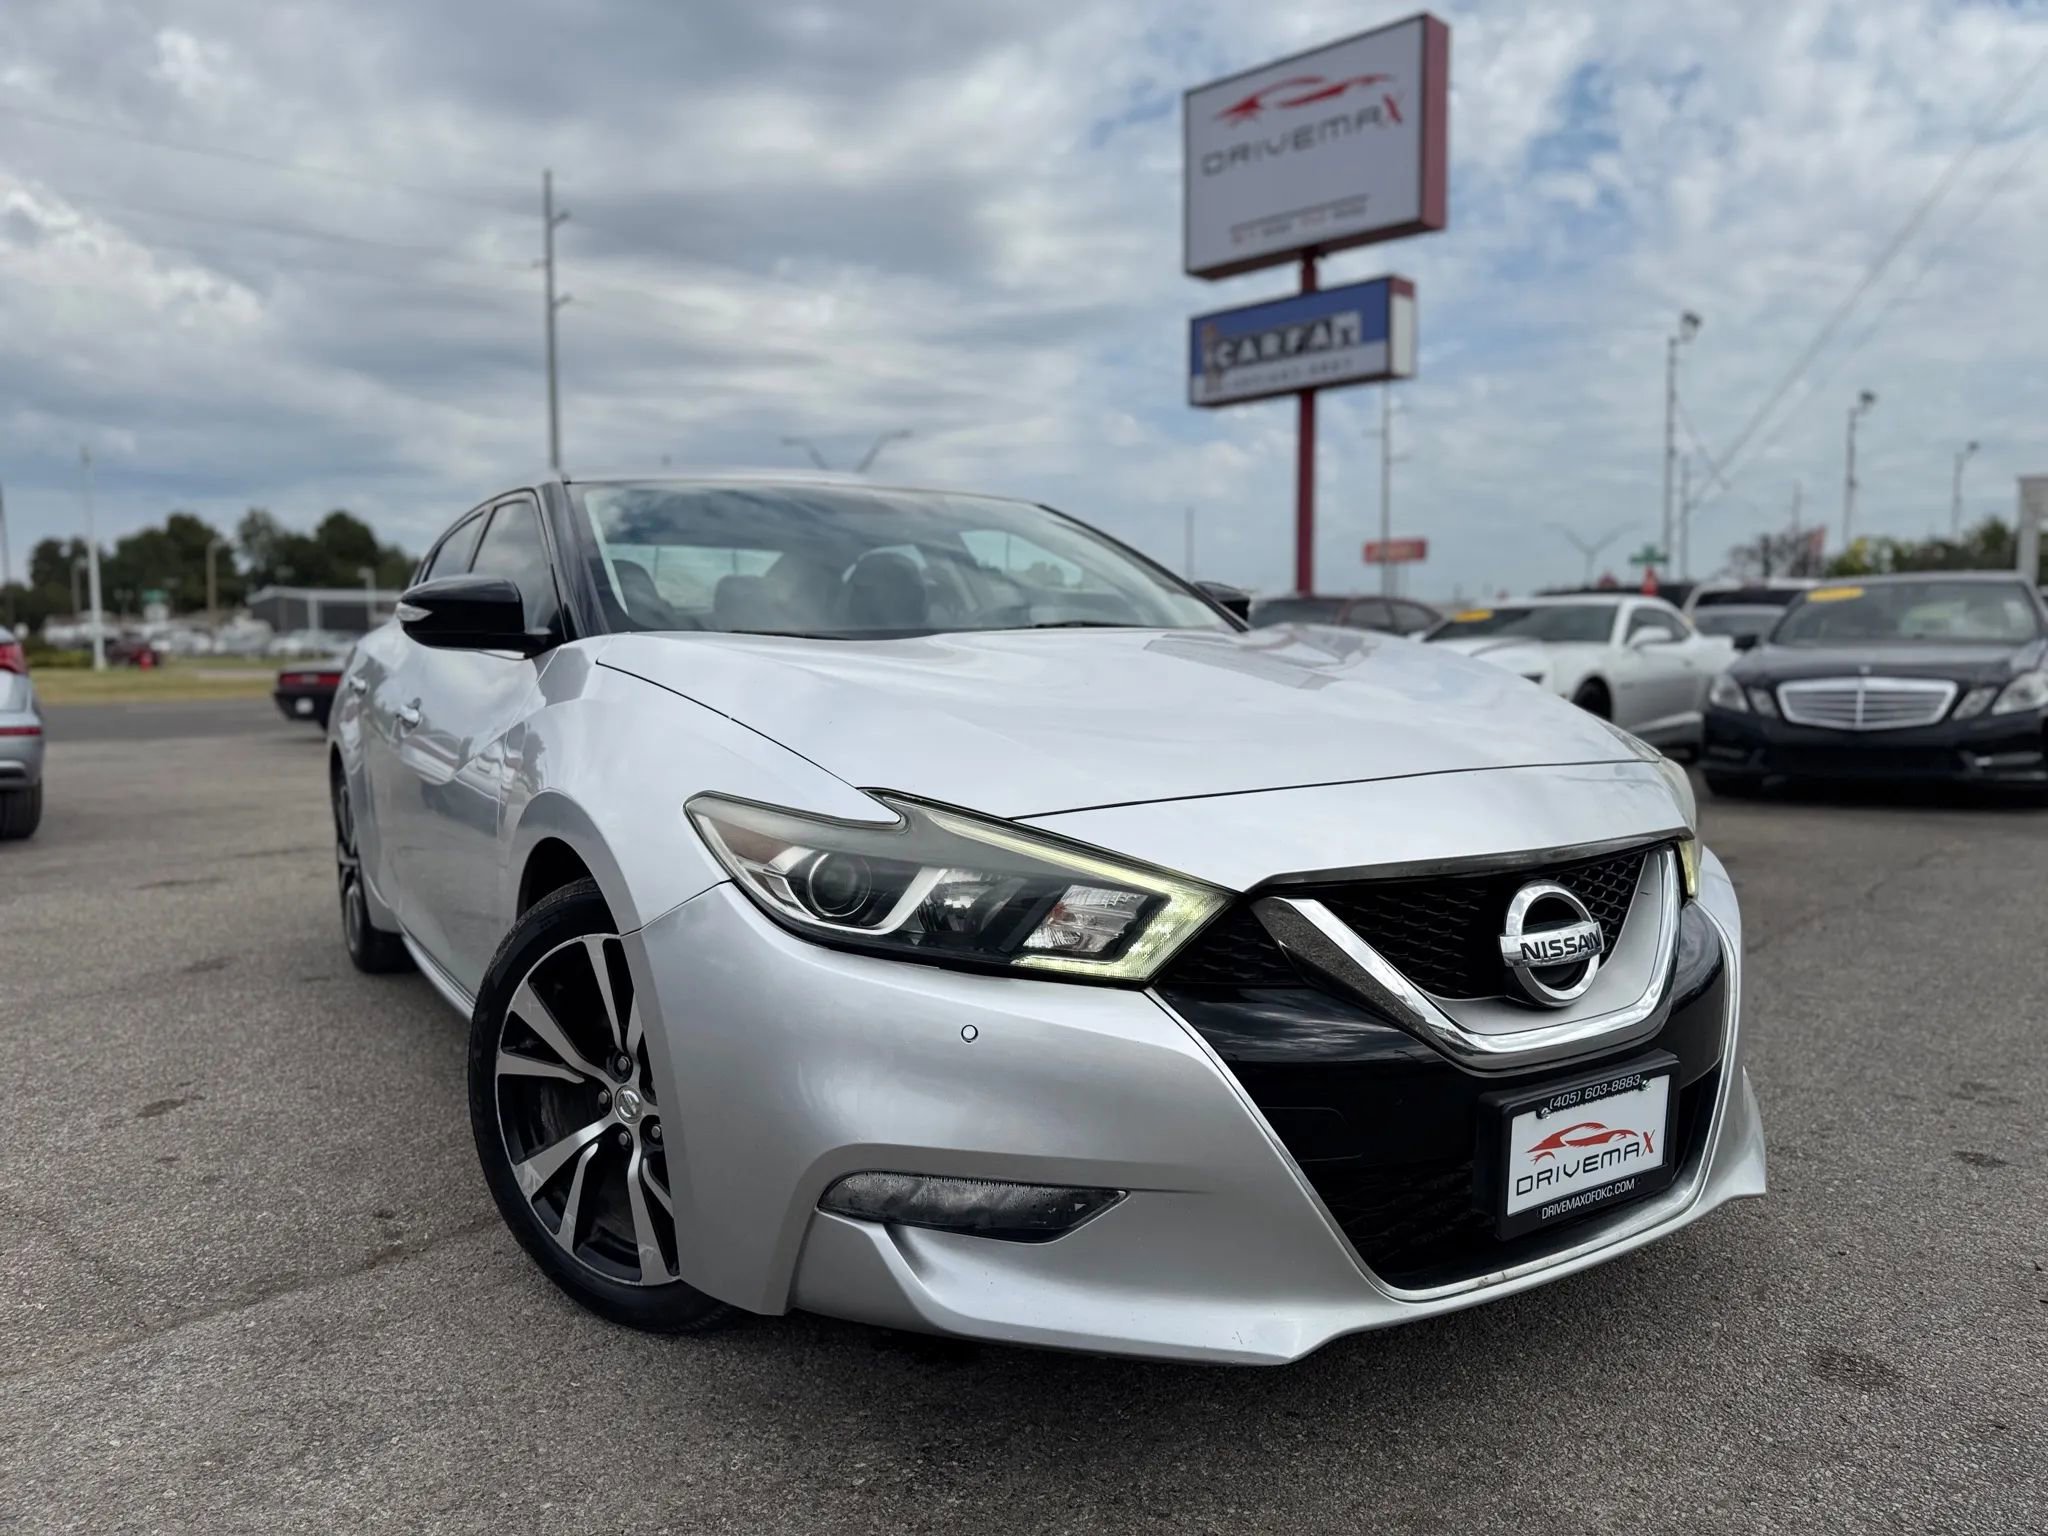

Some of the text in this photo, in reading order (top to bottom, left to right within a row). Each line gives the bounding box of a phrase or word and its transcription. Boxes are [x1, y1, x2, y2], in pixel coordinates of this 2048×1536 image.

[1201, 92, 1403, 177] DRIVEMAX
[1520, 930, 1601, 961] NISSAN
[1549, 1074, 1641, 1109] (405) 603-8883
[1516, 1129, 1656, 1196] DRIVEMAX
[1541, 1178, 1635, 1220] DRIVEMAXOFOKC.COM
